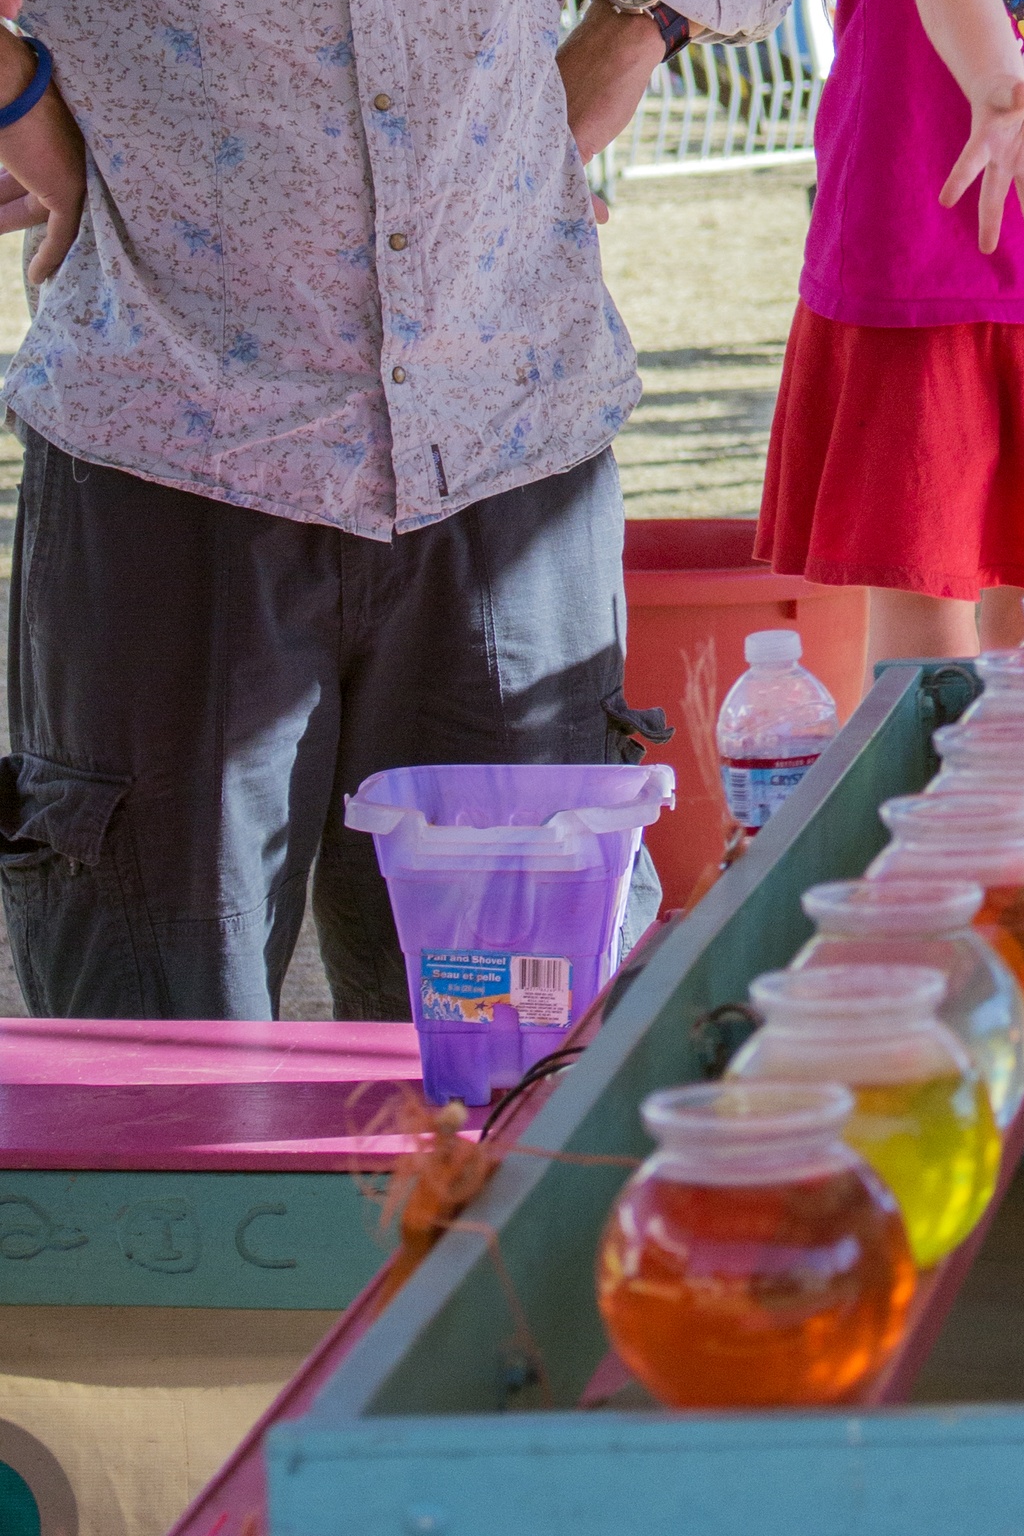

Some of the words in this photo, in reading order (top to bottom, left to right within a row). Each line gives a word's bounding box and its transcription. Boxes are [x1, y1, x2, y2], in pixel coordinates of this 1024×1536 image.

[450, 955, 469, 963] and
[472, 955, 506, 965] Shovel
[432, 970, 460, 979] Seau
[462, 972, 474, 980] et
[476, 973, 502, 983] pelle
